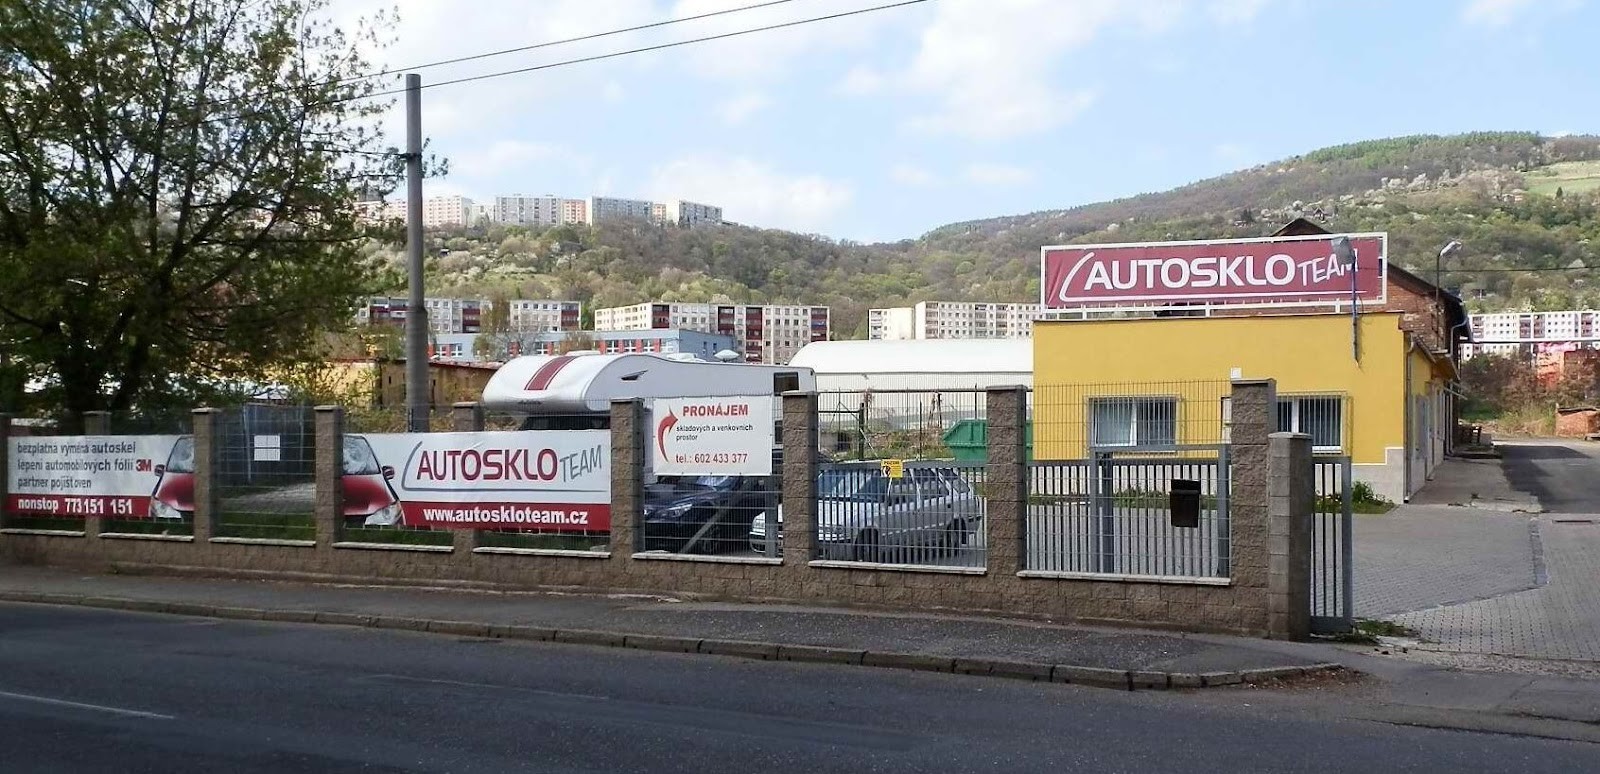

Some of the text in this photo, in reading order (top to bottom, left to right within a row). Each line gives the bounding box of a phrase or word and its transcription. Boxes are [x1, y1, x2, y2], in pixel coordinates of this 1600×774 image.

[1084, 254, 1296, 291] AUTOSKLO
[683, 402, 748, 416] PRONÁJEM
[676, 434, 698, 442] prostor
[91, 441, 136, 453] autoskel
[136, 458, 152, 472] 3M
[416, 444, 602, 482] AUTOSKLO TEAM
[676, 453, 748, 463] tel.: 602 433 377
[17, 476, 49, 490] partner
[18, 497, 59, 513] nonstop
[110, 499, 133, 514] 151
[423, 506, 588, 524] www.autoskloteam.cz
